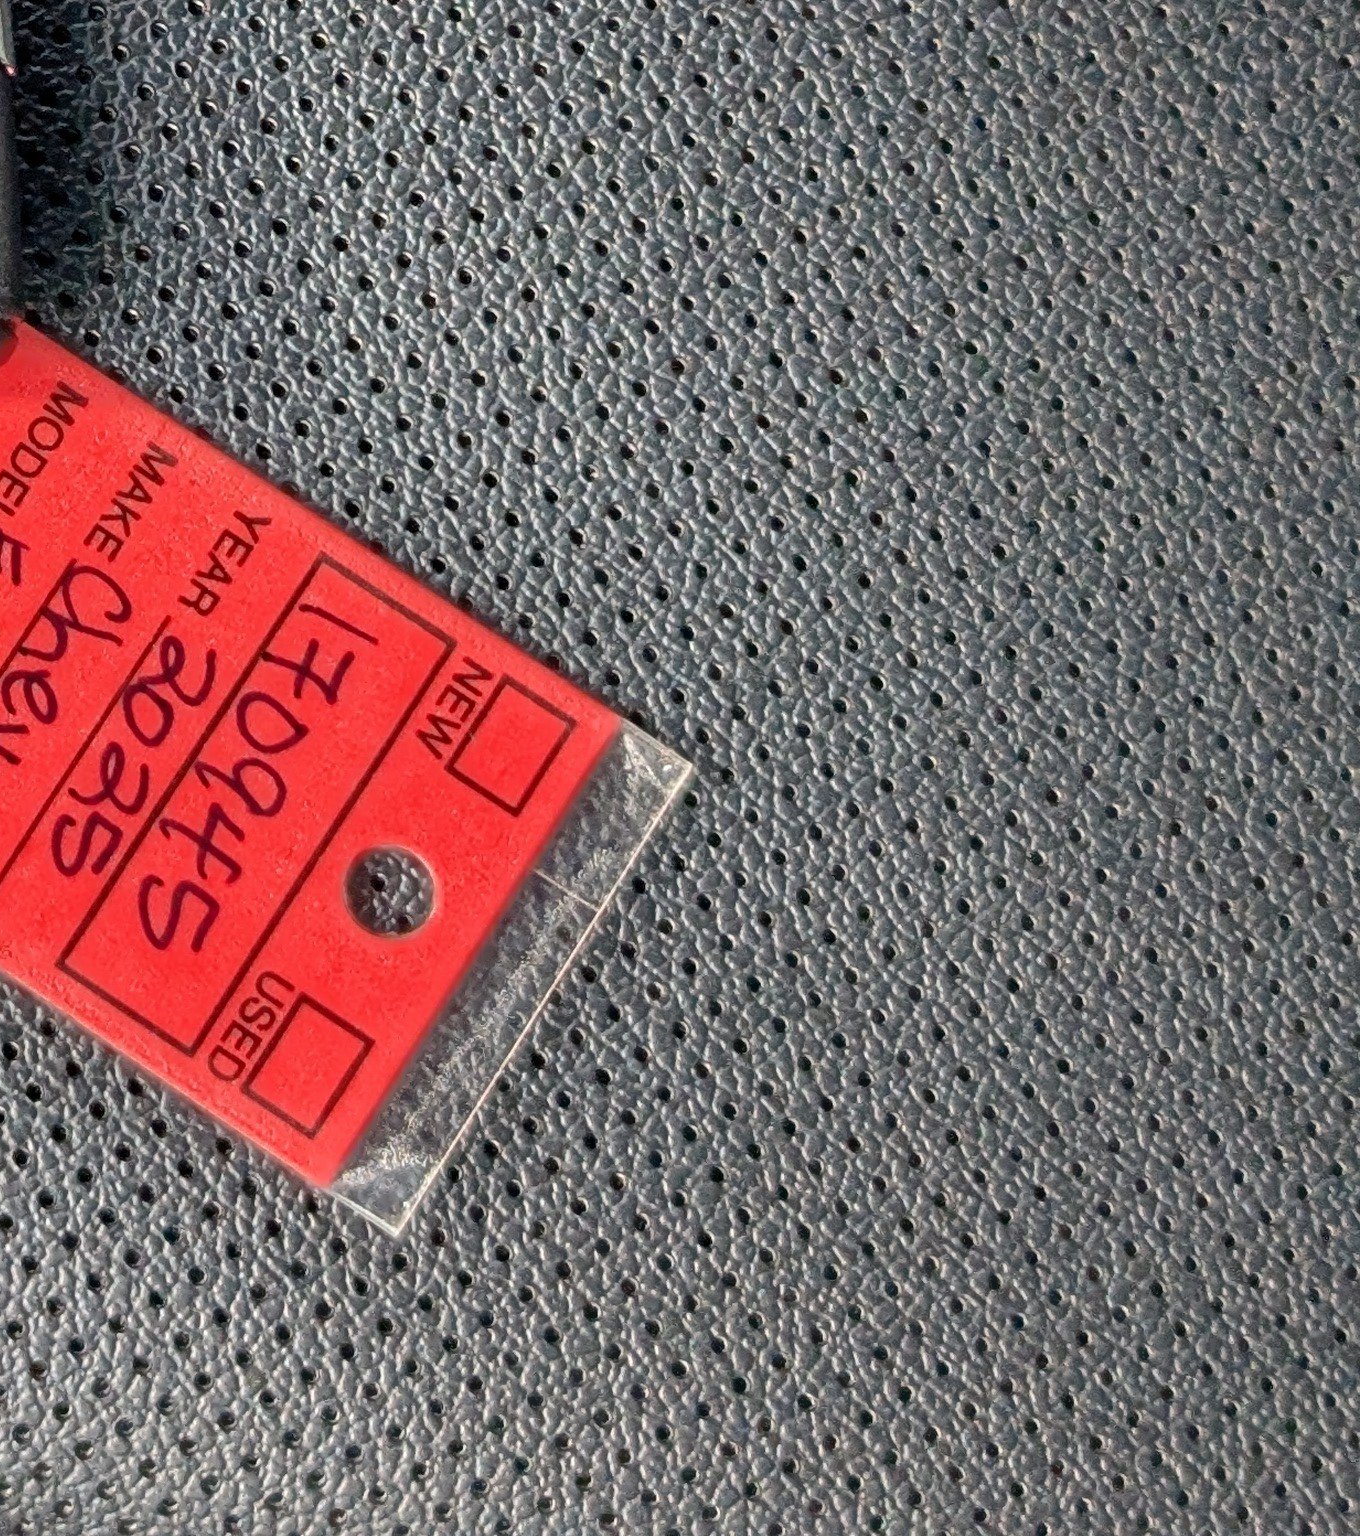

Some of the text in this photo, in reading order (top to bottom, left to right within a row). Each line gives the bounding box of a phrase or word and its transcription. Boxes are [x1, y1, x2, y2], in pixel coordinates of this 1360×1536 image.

[83, 441, 178, 562] MAKE
[178, 510, 273, 617] YEAR
[51, 634, 217, 879] 2025
[416, 656, 496, 761] NEW
[137, 602, 380, 953] 170945
[207, 970, 296, 1084] USED
